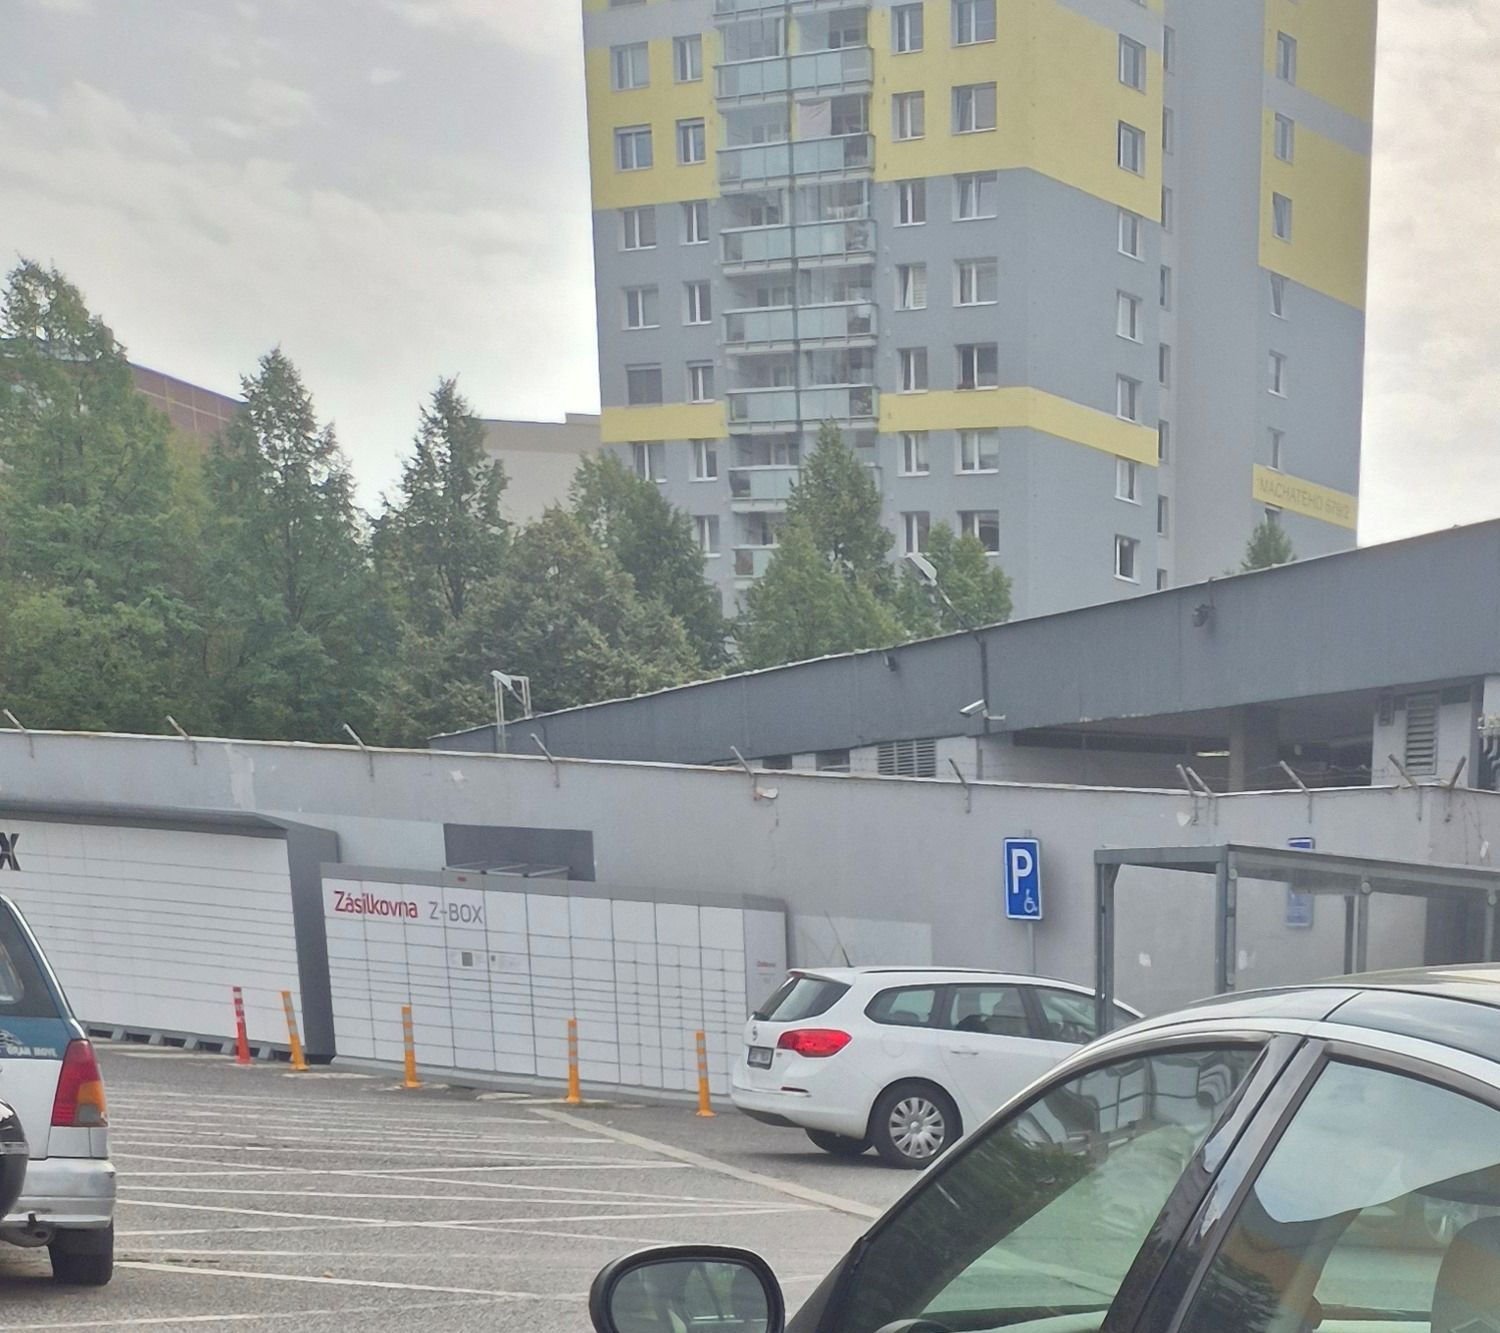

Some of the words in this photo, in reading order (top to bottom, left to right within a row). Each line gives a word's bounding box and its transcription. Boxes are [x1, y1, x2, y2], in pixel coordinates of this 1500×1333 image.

[1011, 848, 1033, 894] P
[334, 890, 418, 918] Zásilkovna
[429, 901, 484, 924] Z-BOX
